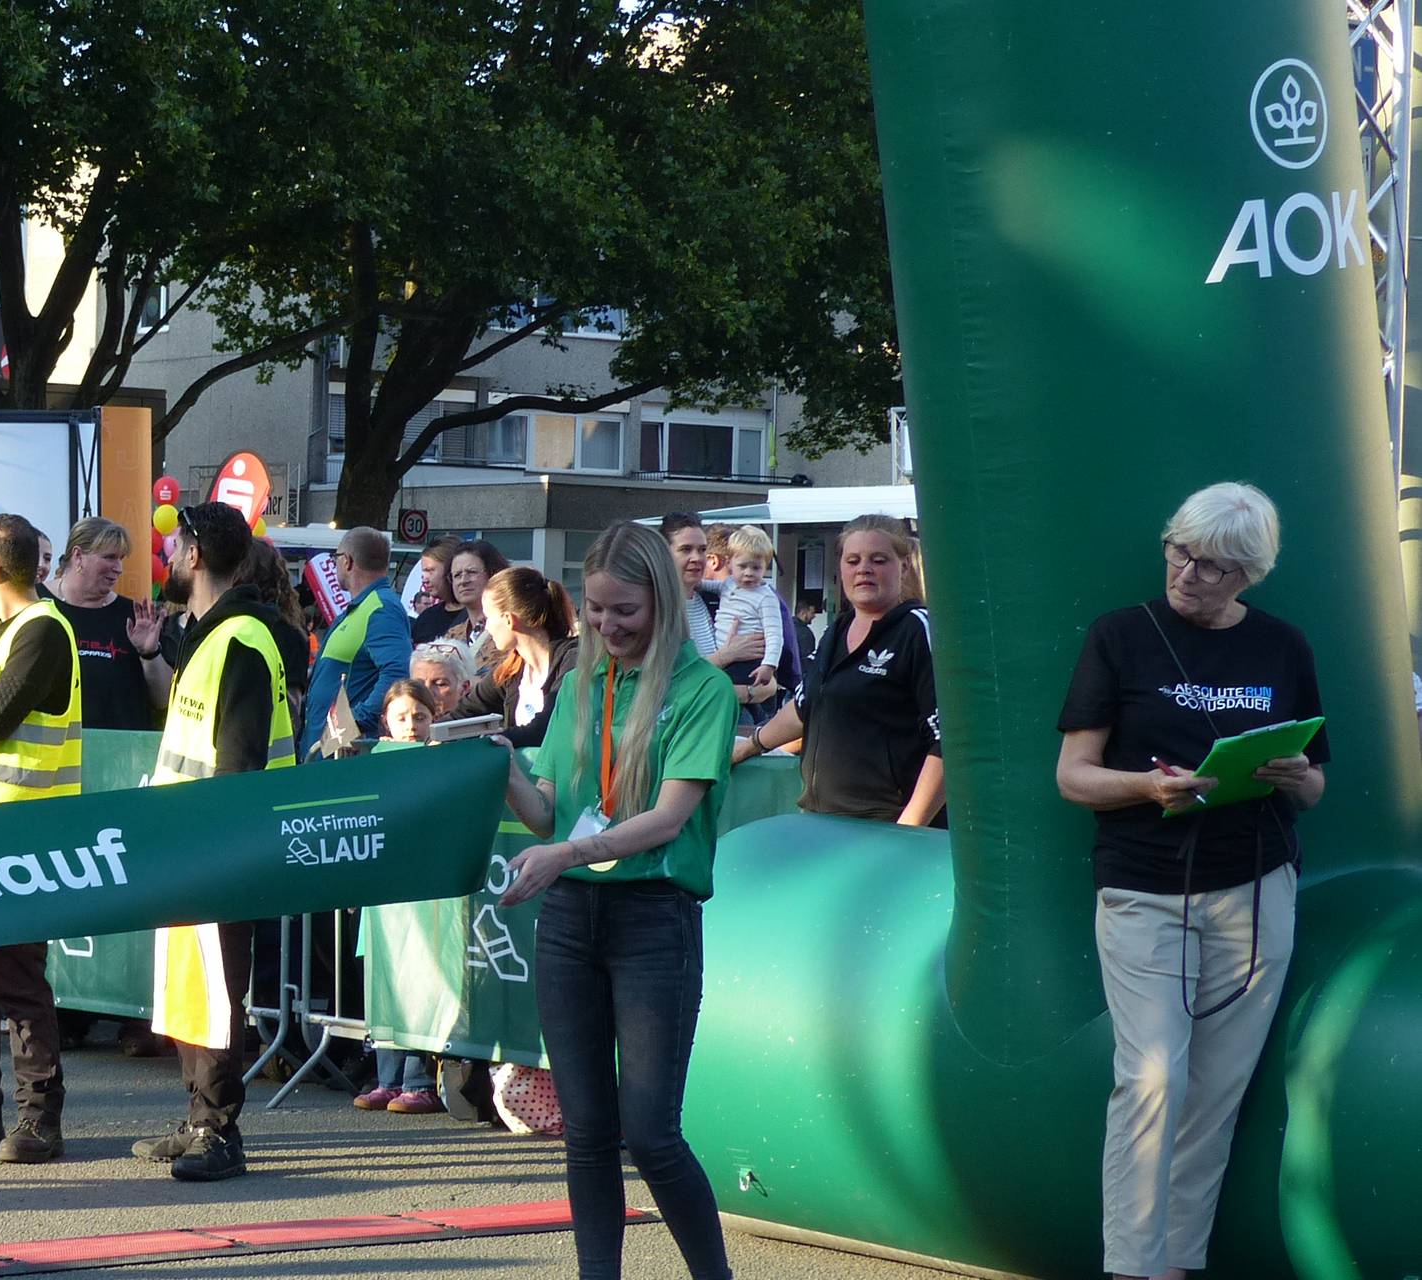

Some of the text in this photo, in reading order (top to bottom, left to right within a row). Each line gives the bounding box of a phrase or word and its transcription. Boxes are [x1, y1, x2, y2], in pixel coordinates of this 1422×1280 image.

[1205, 189, 1366, 284] AOK
[407, 519, 423, 532] 30
[858, 664, 887, 676] adidas
[281, 814, 384, 836] AOK-Firmen-
[319, 833, 385, 864] LAUF
